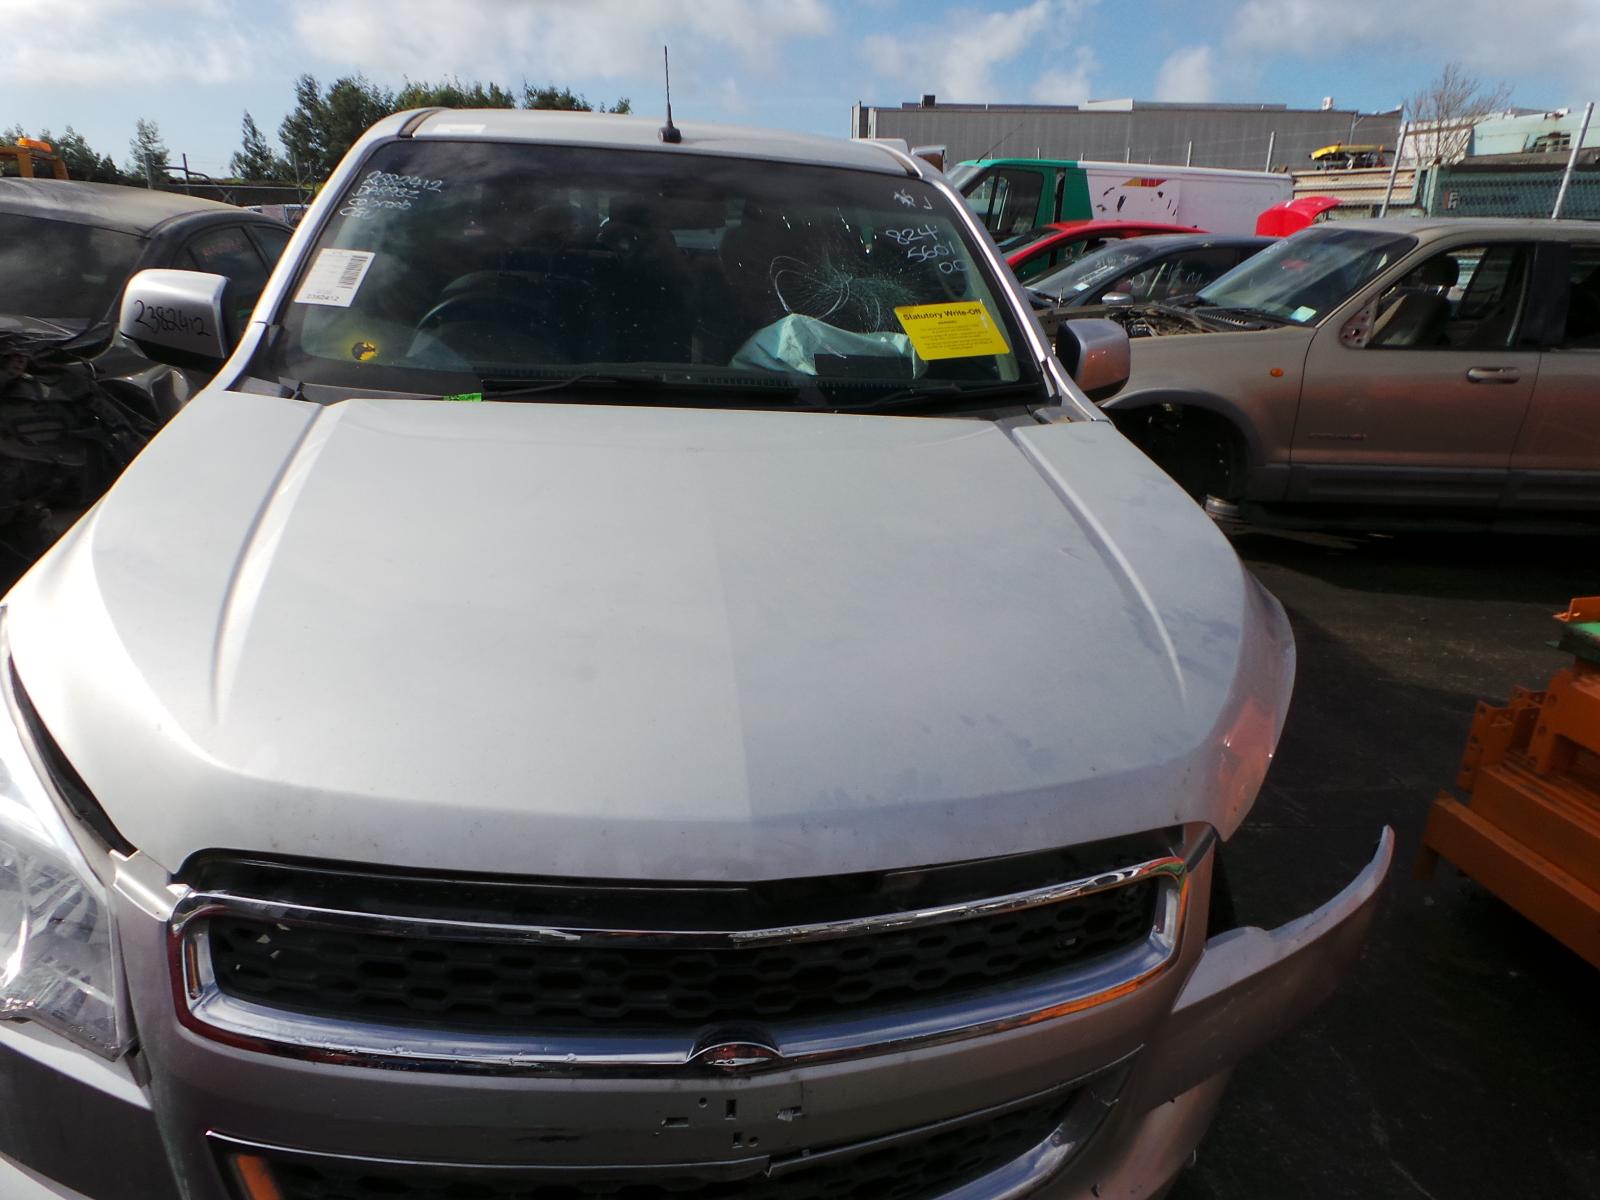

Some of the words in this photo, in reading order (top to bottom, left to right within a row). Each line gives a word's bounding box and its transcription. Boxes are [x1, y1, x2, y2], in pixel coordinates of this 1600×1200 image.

[886, 224, 938, 245] 824
[134, 299, 211, 336] 2382412
[903, 310, 943, 321] Statutory
[944, 307, 982, 318] Write-Off
